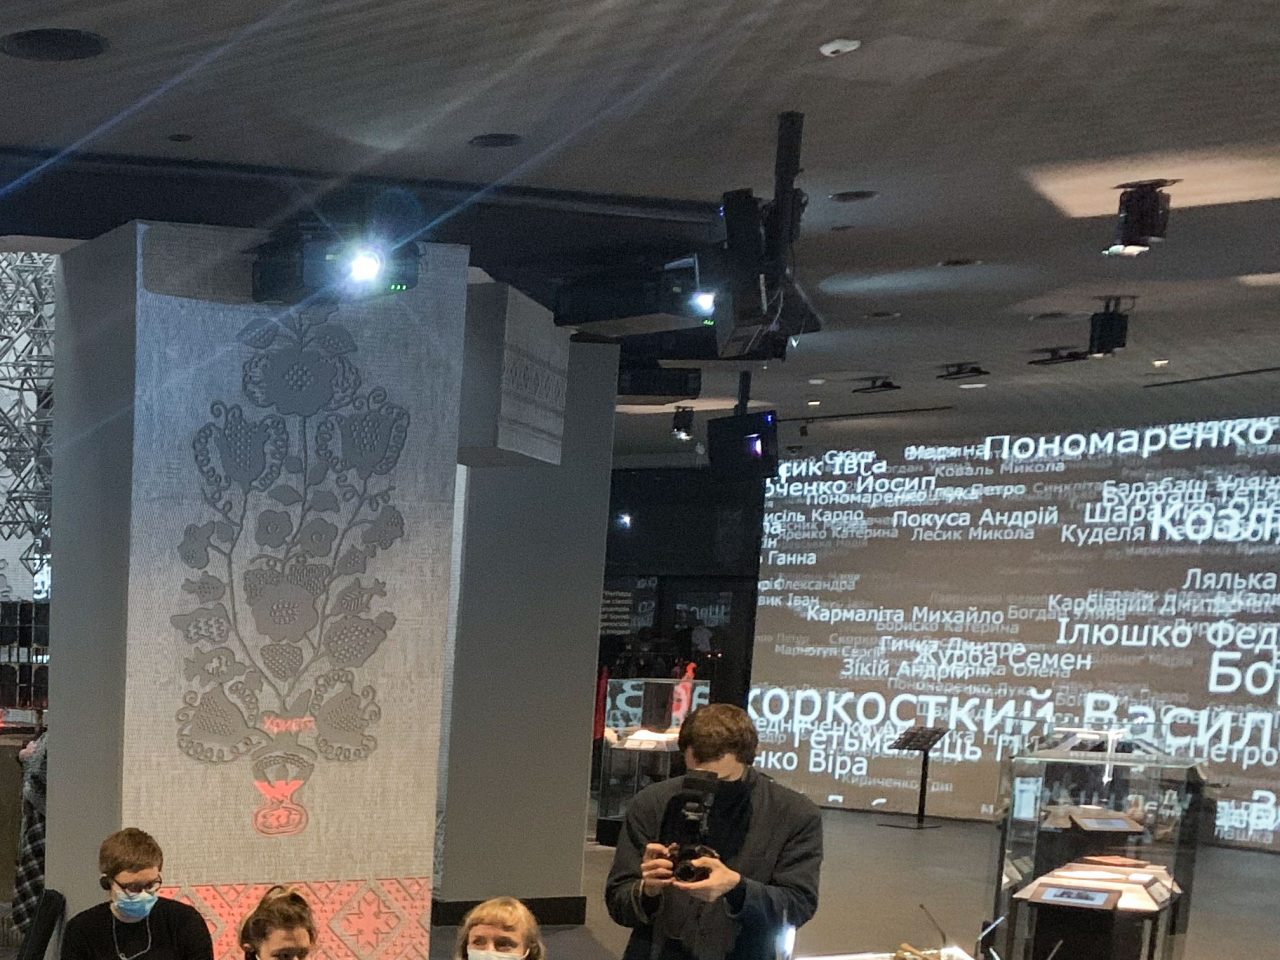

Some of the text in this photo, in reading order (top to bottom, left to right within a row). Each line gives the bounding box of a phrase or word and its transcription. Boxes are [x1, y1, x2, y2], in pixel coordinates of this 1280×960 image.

[984, 421, 1275, 461] Пономаренко
[934, 460, 1066, 478] Коваль Микола
[893, 505, 1059, 534] Покуса Андрій
[911, 527, 1035, 541] Лесик Микола
[1060, 524, 1146, 547] Куделя
[768, 550, 817, 566] Ганна
[1182, 567, 1277, 589] Лялька
[806, 605, 1004, 625] Кармаліта Михайло
[1056, 617, 1193, 648] Ілюшко
[1009, 649, 1092, 670] Семен
[809, 750, 868, 780] Віра
